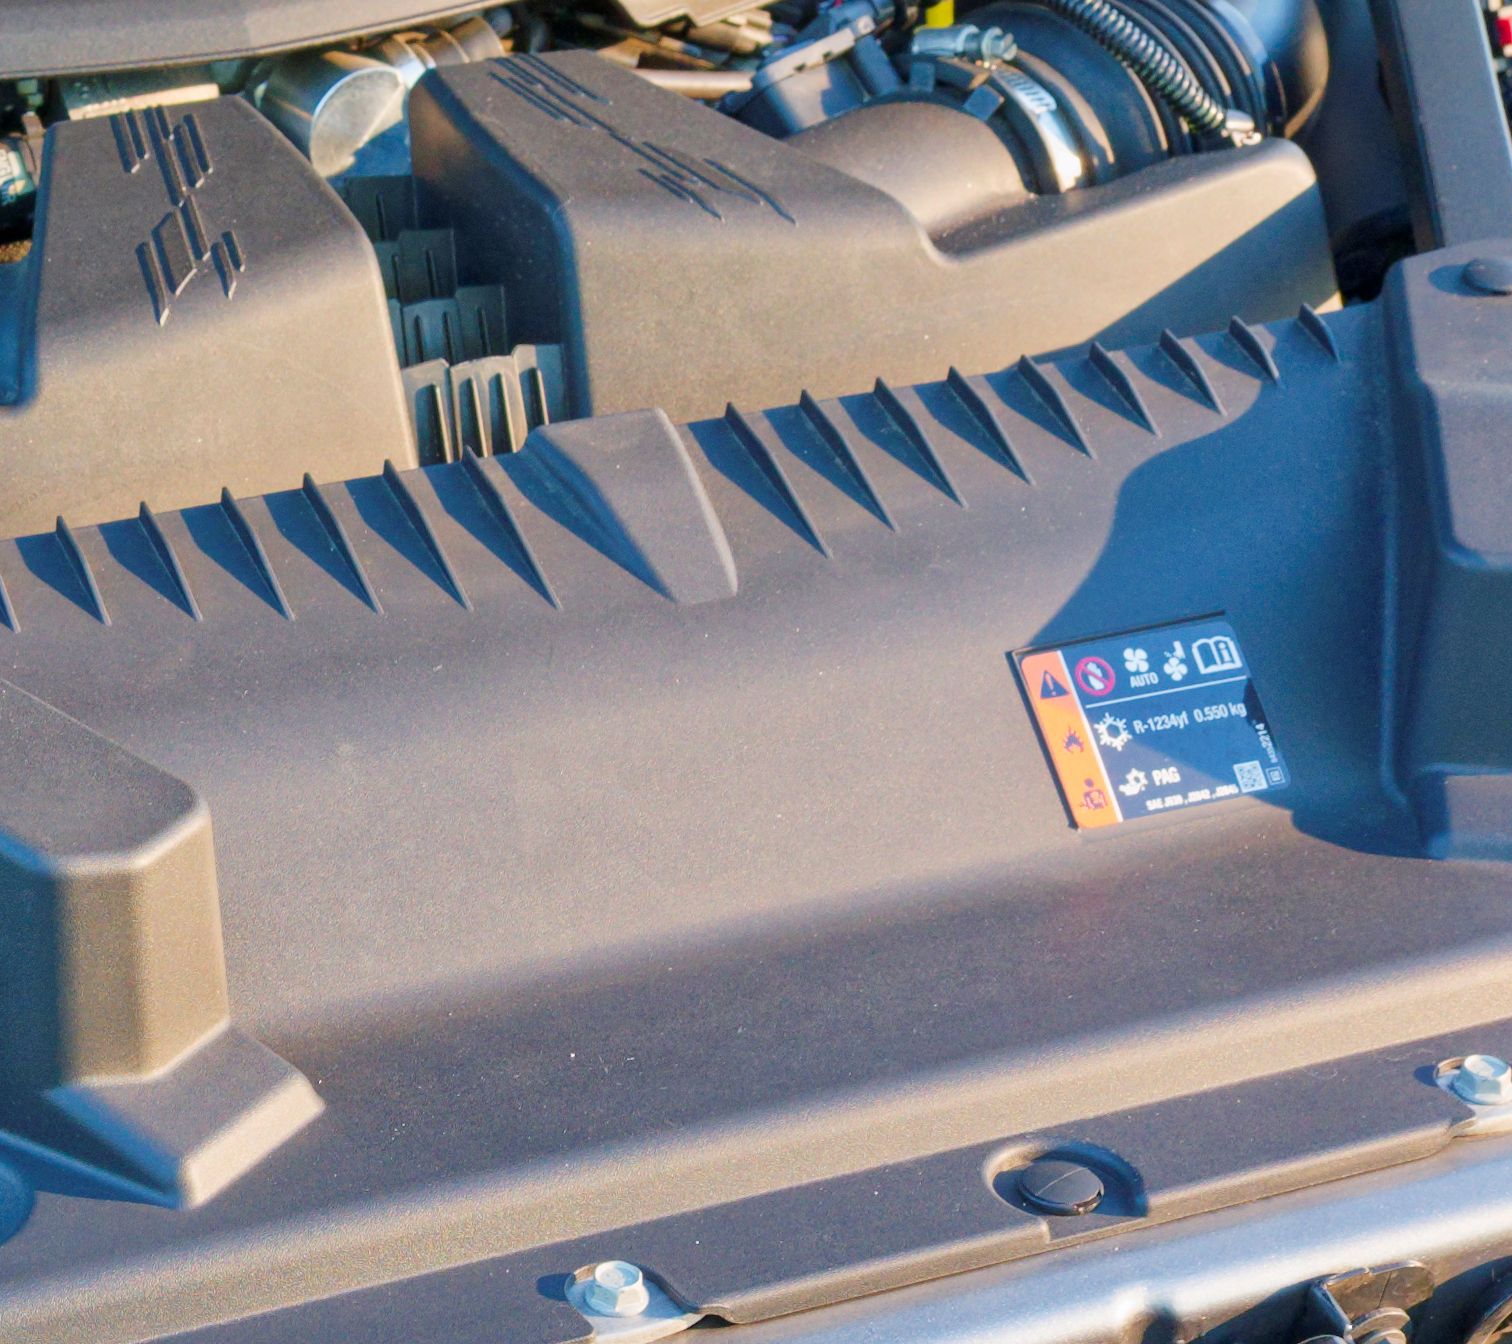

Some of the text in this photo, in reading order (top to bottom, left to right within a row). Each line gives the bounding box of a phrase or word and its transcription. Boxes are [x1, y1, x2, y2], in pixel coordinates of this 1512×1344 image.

[1130, 672, 1159, 688] AUTO
[1133, 702, 1248, 735] R-1234yf 0.550 kg
[1151, 766, 1181, 786] PAG
